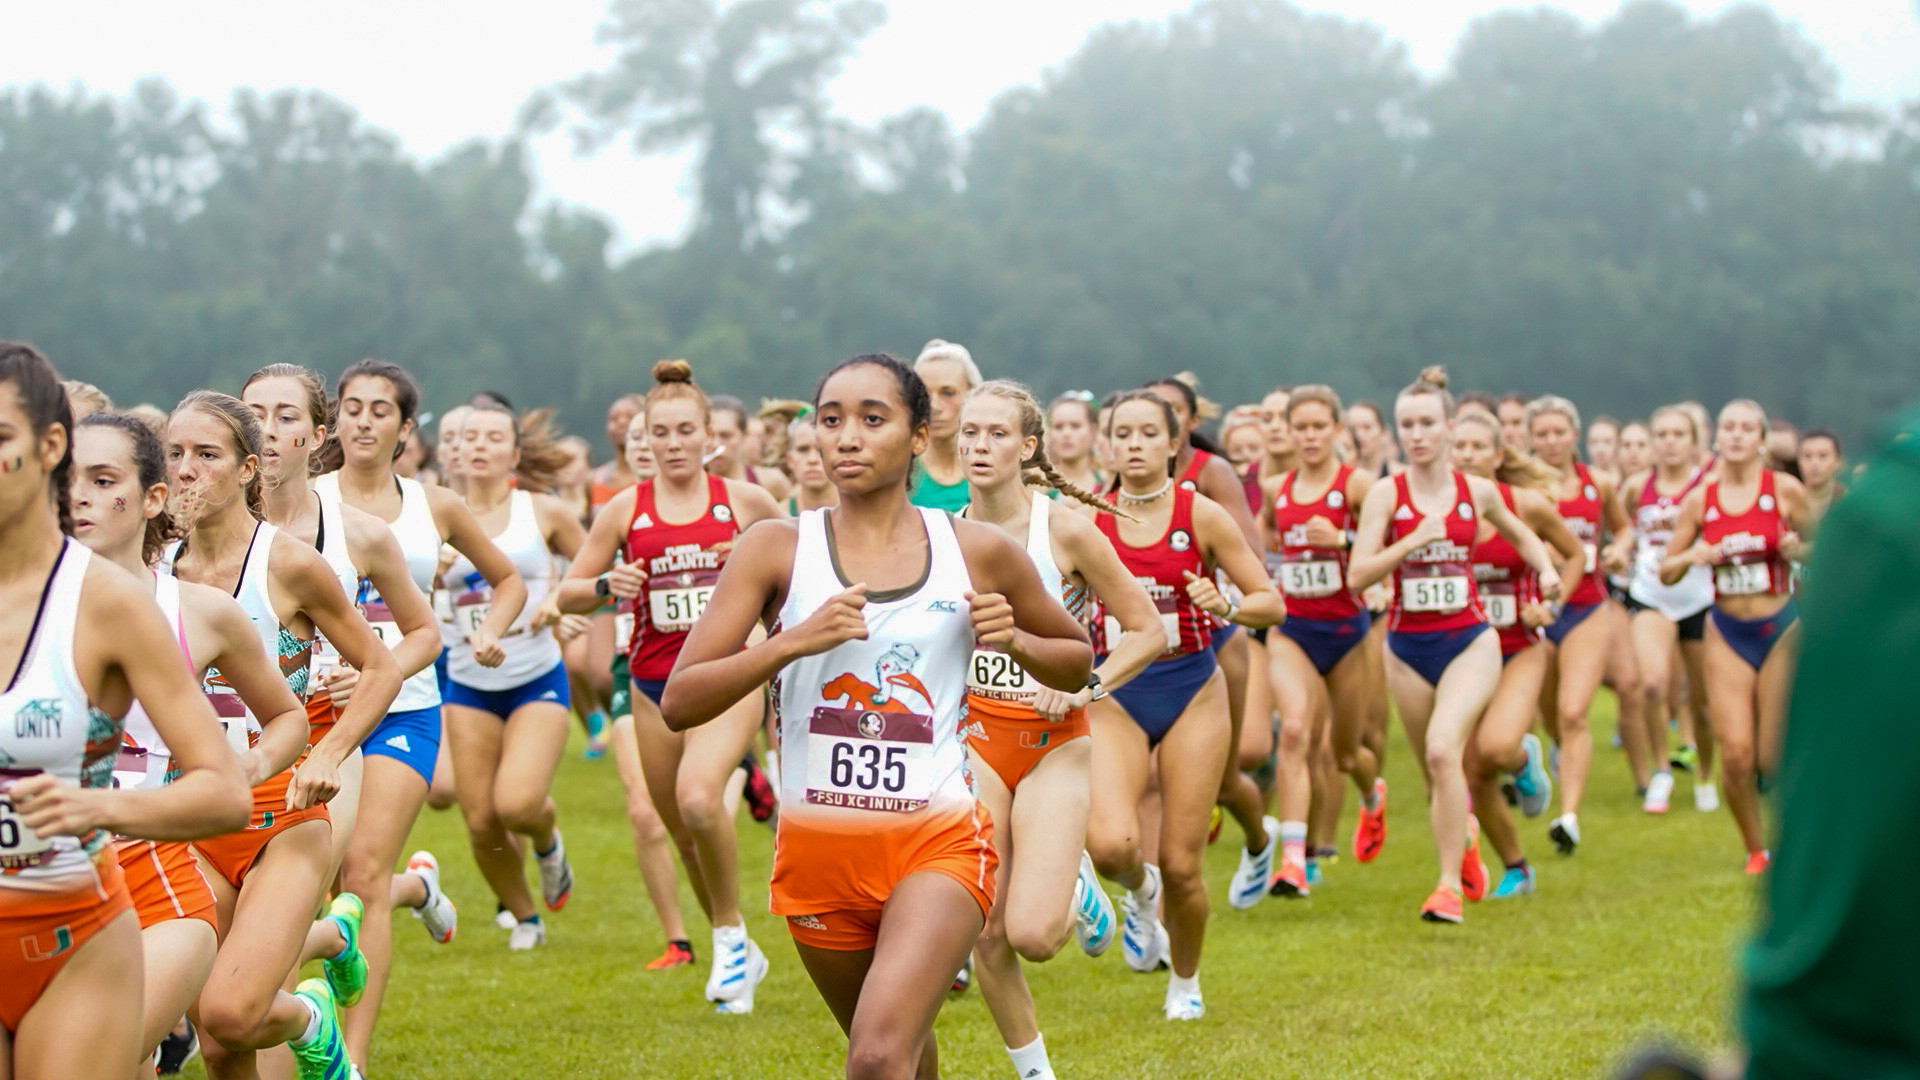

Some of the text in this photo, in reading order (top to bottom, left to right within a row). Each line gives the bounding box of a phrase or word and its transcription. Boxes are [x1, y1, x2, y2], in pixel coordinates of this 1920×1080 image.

[651, 552, 719, 575] ATLANTIC
[1293, 565, 1327, 588] 514
[1416, 581, 1455, 605] 518
[666, 591, 709, 620] 515
[925, 600, 957, 613] ACC
[974, 655, 1024, 688] 629
[987, 690, 1000, 698] XC
[14, 712, 62, 738] UNITY
[1019, 731, 1050, 749] U
[830, 742, 907, 792] 635
[816, 790, 843, 805] FSU
[847, 794, 866, 808] XC
[20, 924, 75, 963] U
